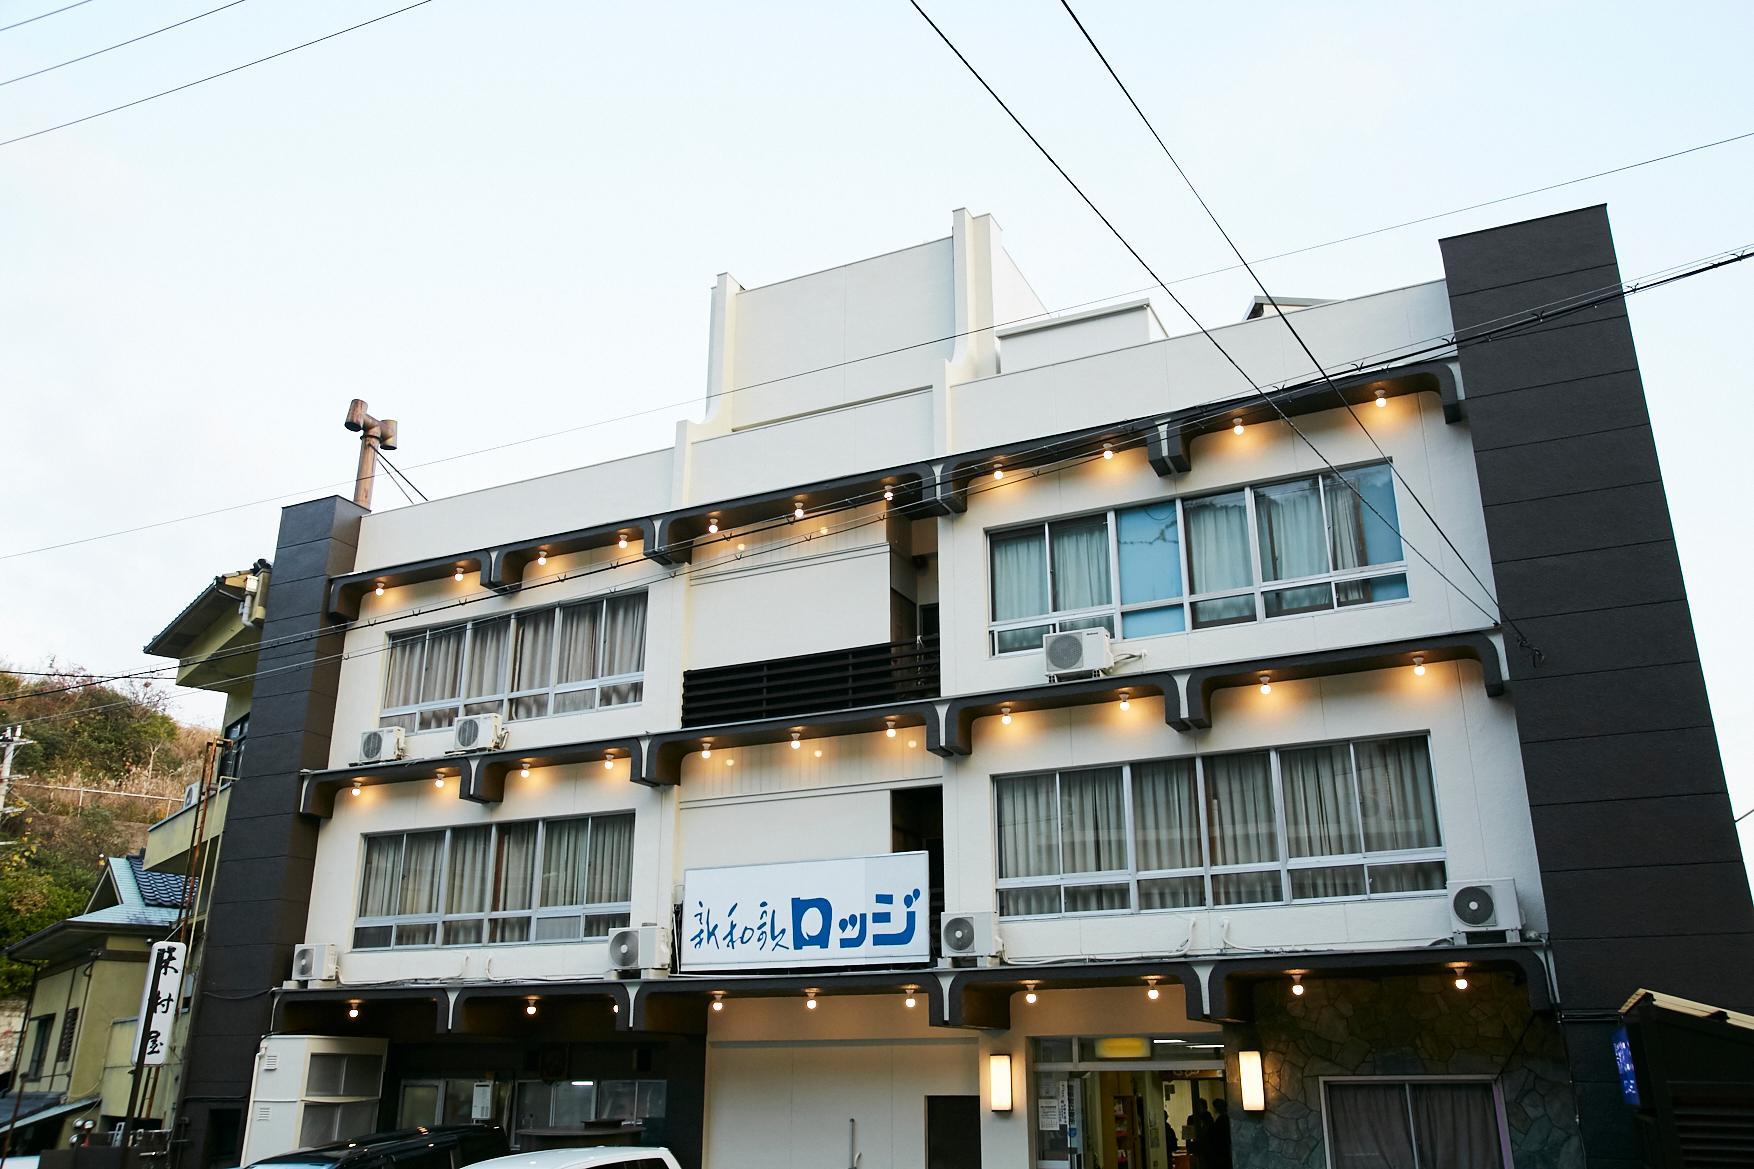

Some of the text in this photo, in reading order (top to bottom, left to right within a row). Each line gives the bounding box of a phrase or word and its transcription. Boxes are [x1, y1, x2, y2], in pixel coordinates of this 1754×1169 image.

[690, 888, 921, 951] 新和歌ロッジ
